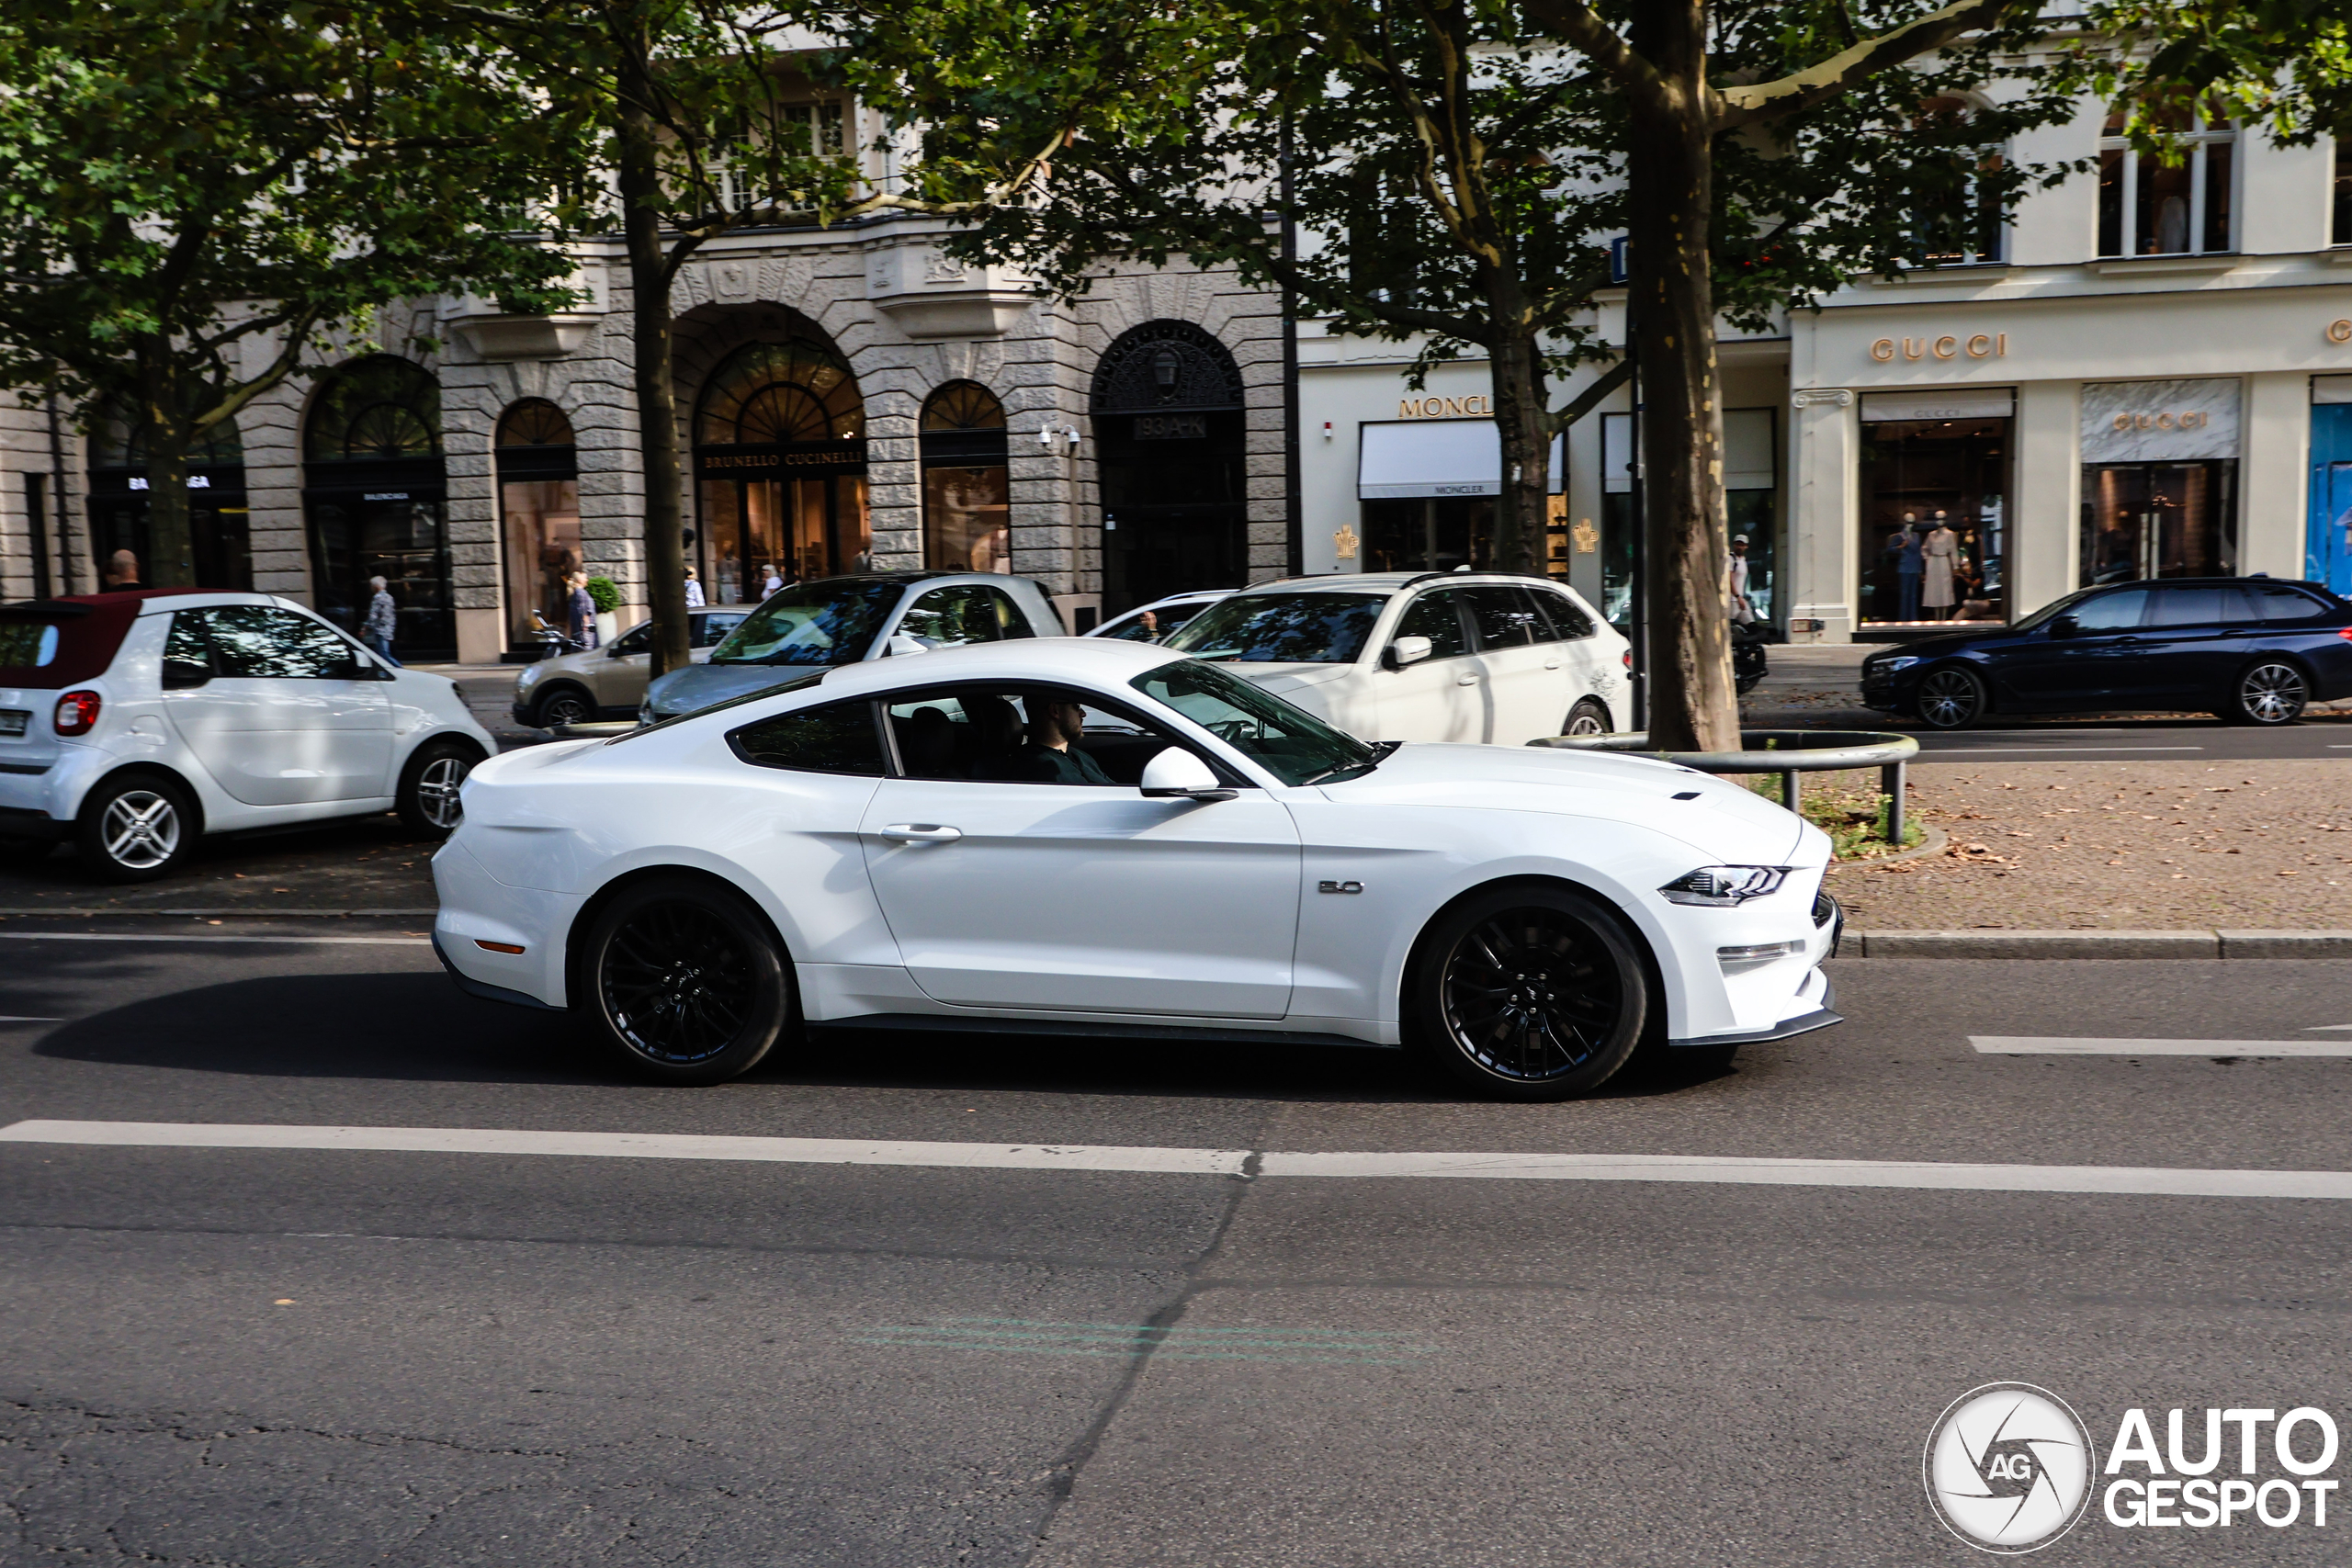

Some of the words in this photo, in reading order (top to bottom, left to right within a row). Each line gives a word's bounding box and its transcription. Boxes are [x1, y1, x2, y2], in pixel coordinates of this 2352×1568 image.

[1871, 333, 2007, 362] GUCCI
[1915, 409, 1961, 418] GUCCI
[2113, 412, 2208, 430] GUCCI
[704, 455, 779, 468] BRUNELLO
[785, 451, 863, 465] CUCINELLI
[1435, 485, 1485, 495] MONCLER
[1318, 880, 1364, 894] 5.0
